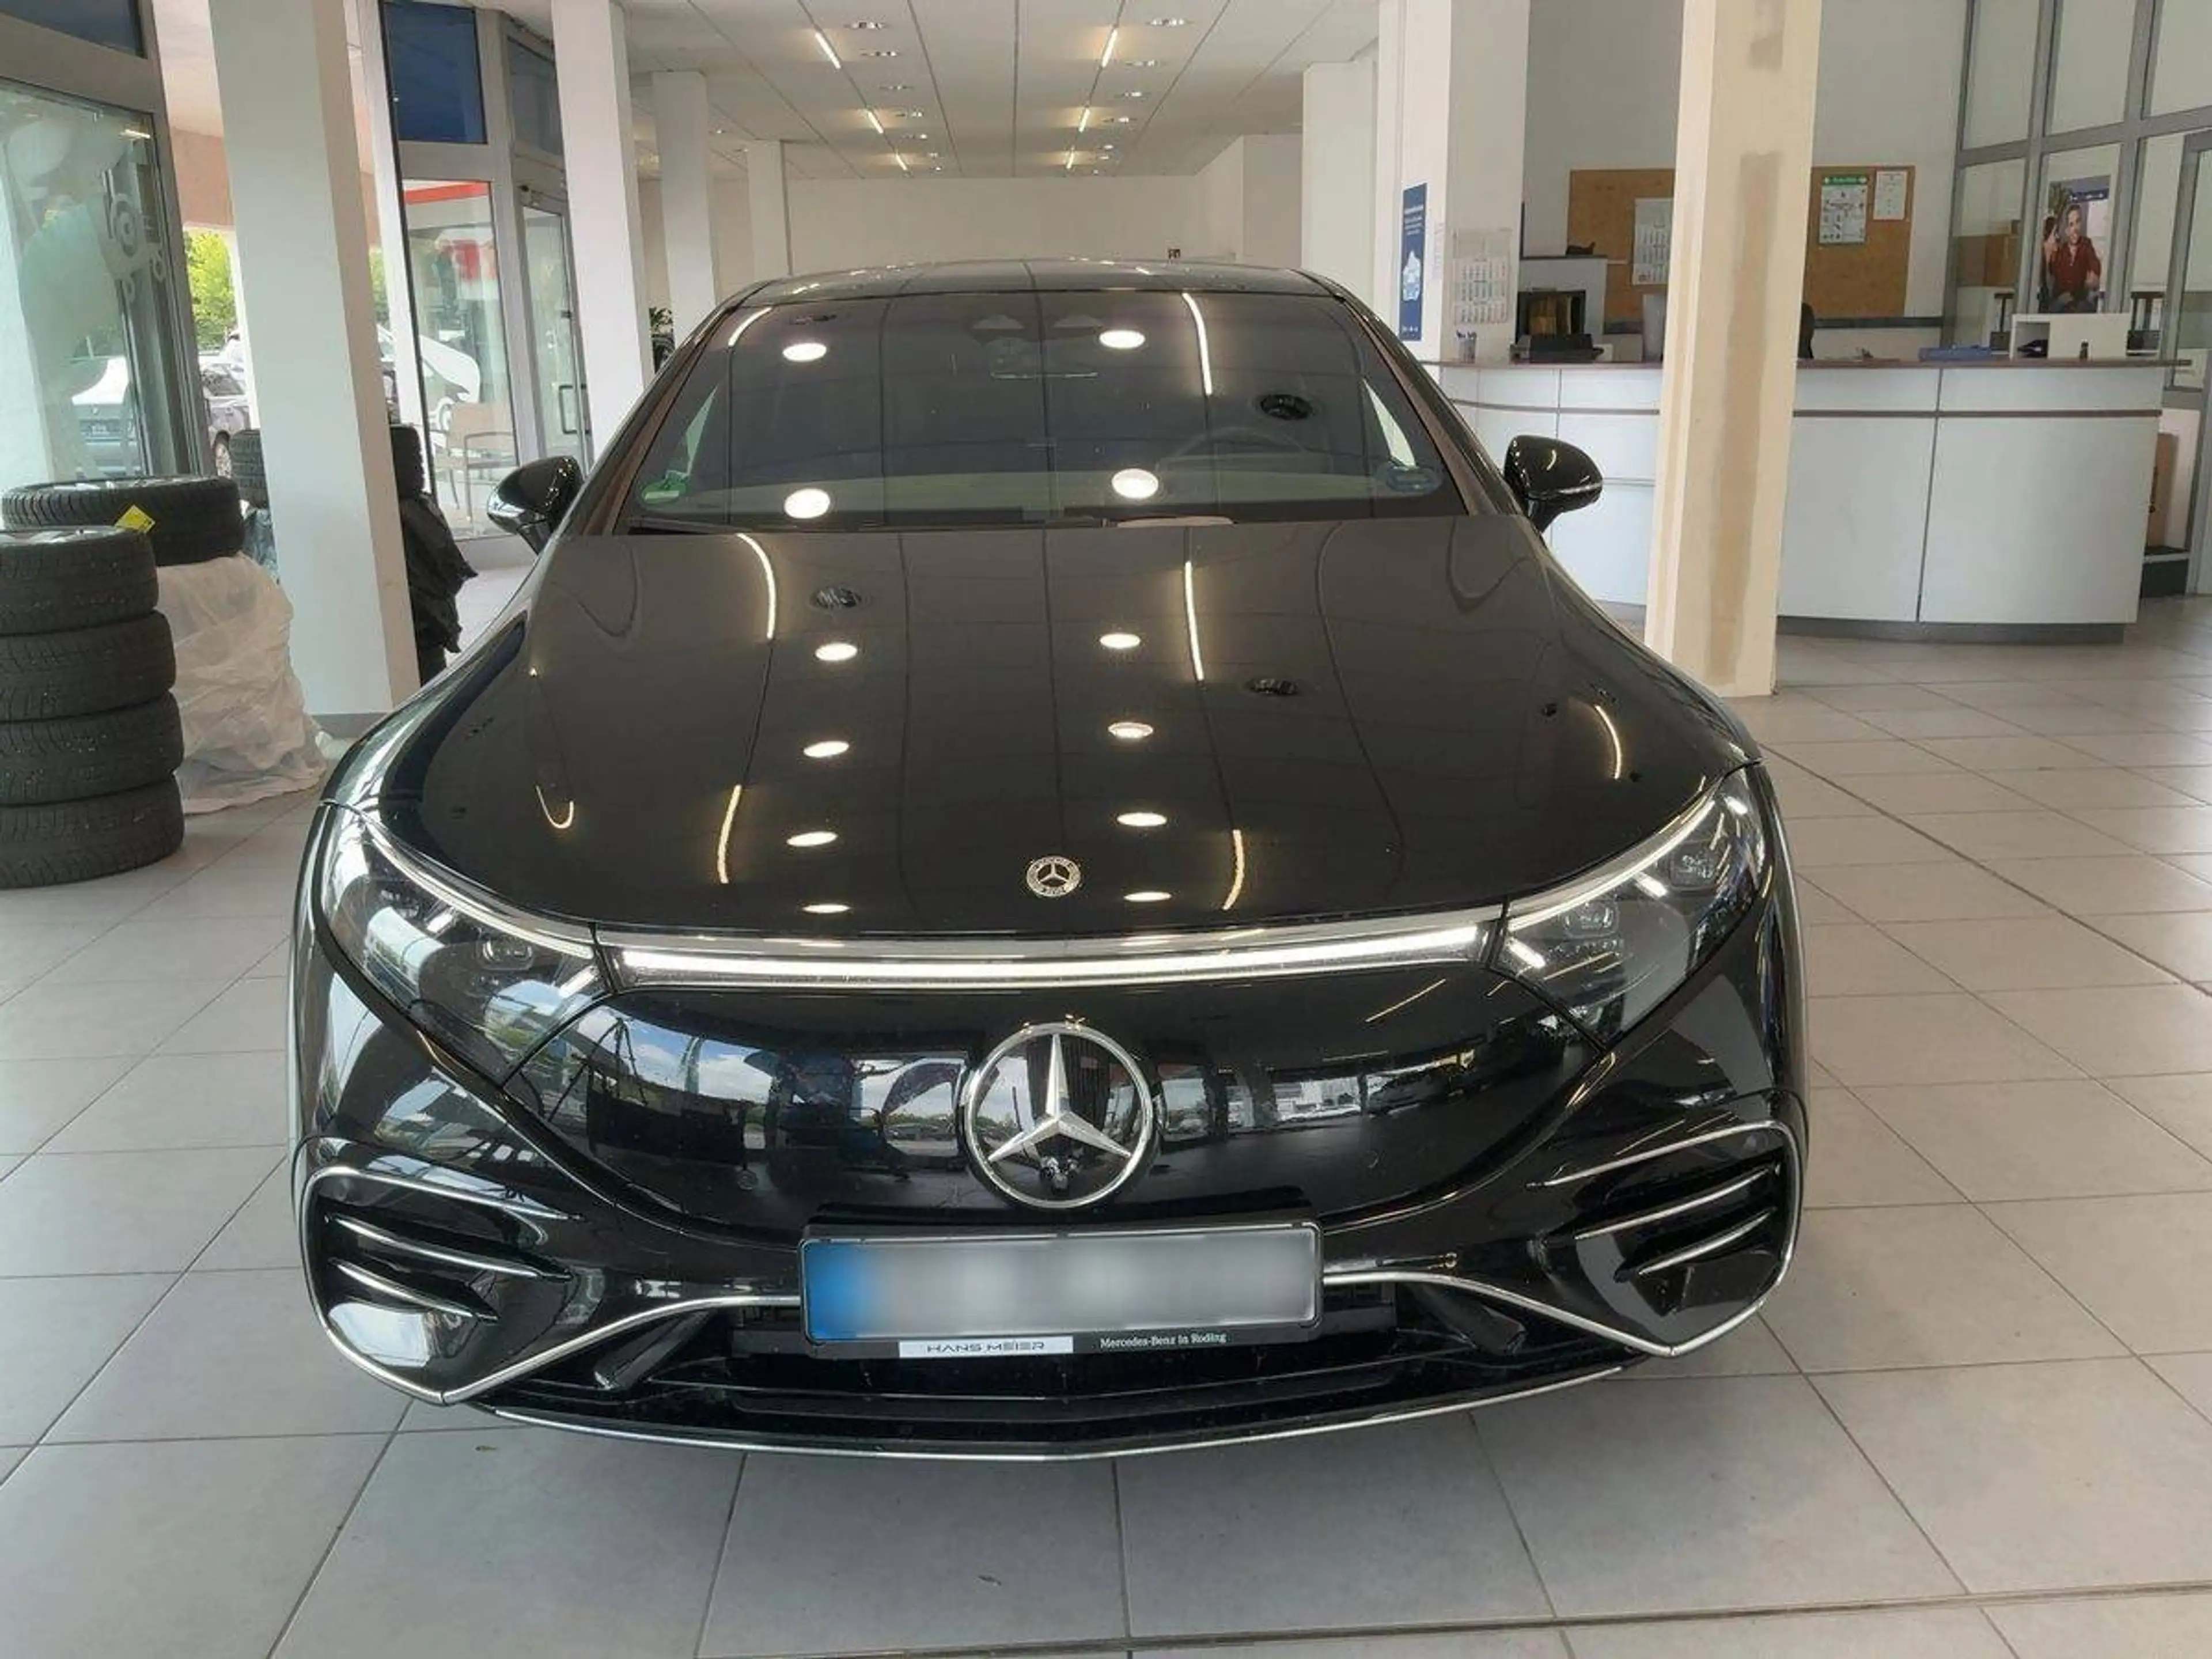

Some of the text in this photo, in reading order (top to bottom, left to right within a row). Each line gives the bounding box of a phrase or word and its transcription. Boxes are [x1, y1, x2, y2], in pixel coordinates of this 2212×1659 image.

[927, 1341, 1045, 1353] HANS MEIER
[1100, 1335, 1176, 1348] Mercedes-Benz
